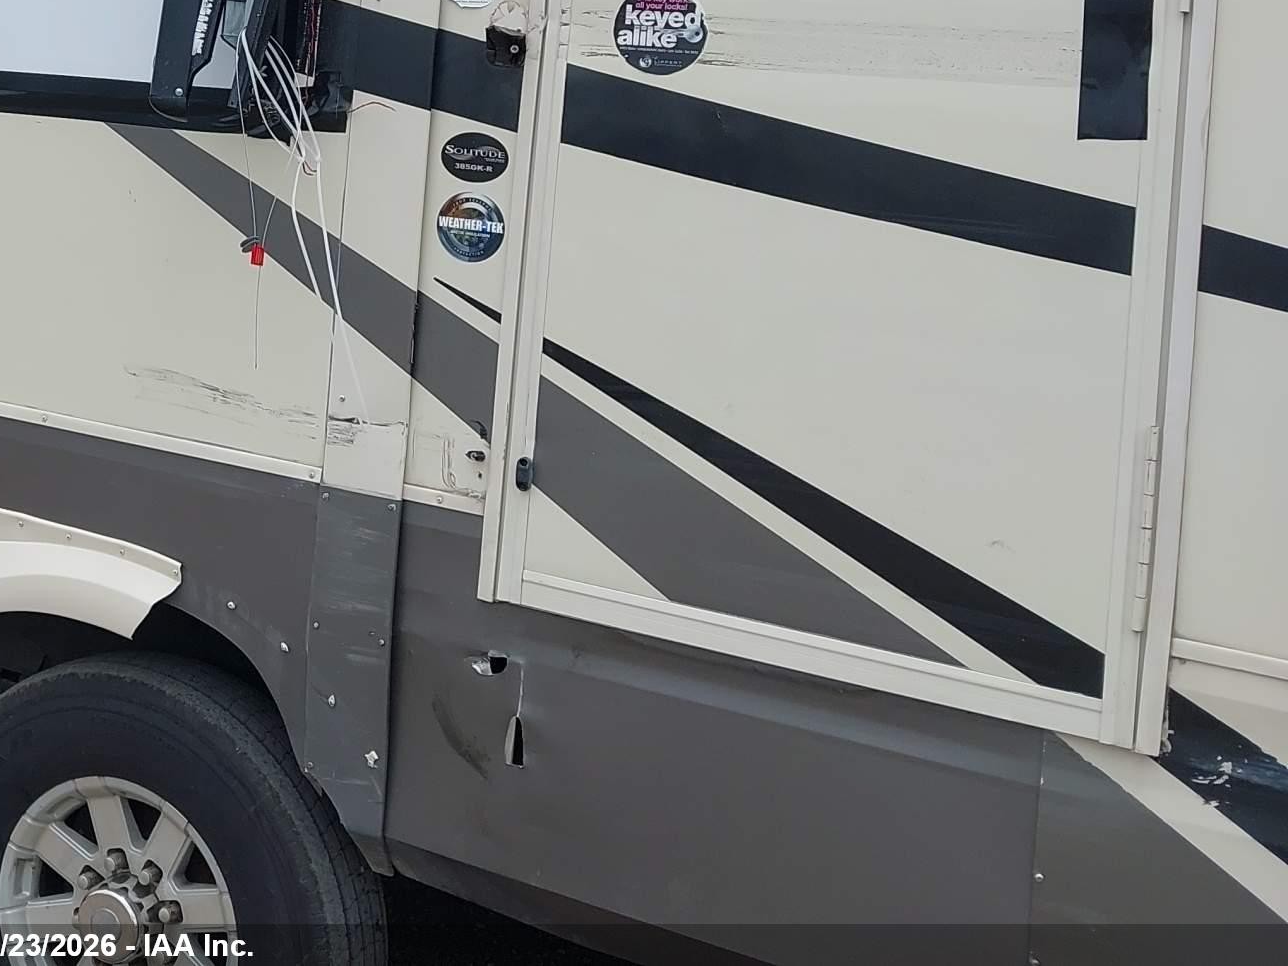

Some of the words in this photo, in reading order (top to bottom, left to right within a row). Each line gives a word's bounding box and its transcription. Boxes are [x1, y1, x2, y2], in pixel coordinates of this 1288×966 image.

[635, 1, 645, 9] all
[646, 2, 663, 11] your
[624, 4, 702, 31] keyed
[617, 25, 678, 49] alike
[438, 215, 505, 234] WEATHER-TEK
